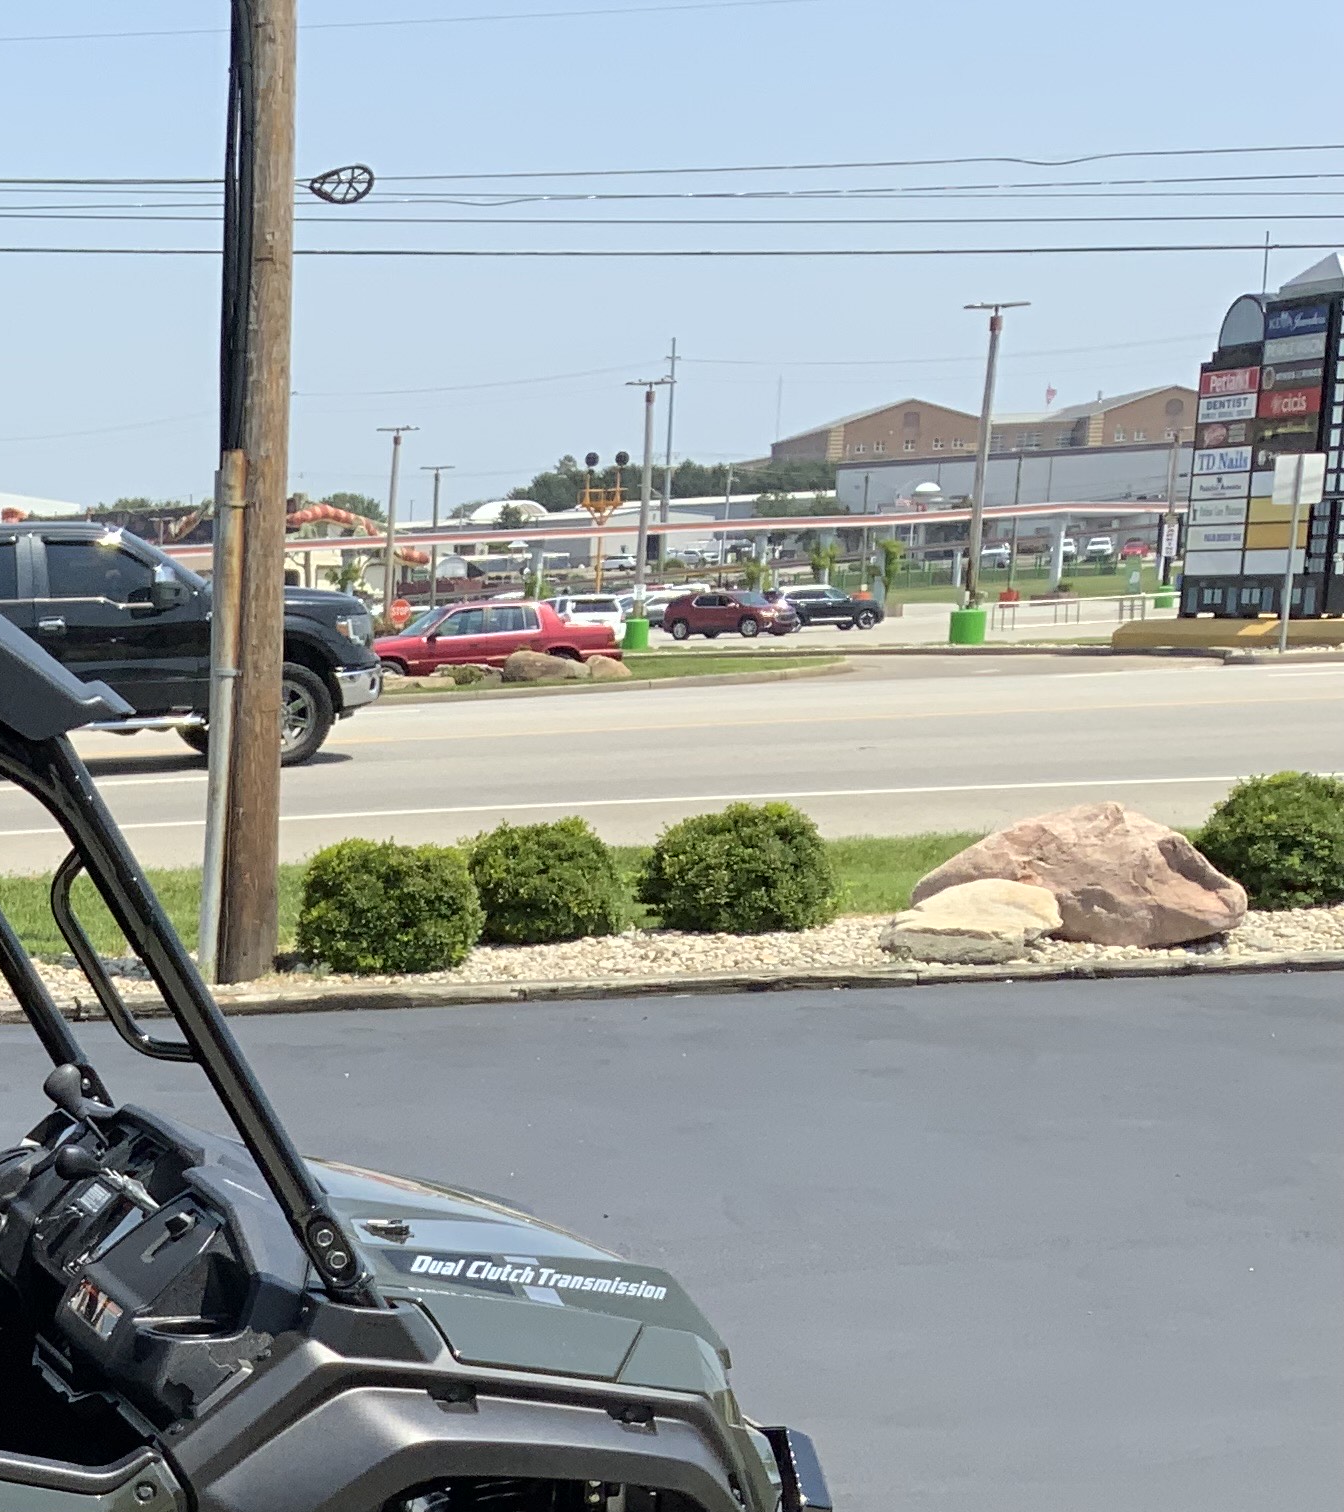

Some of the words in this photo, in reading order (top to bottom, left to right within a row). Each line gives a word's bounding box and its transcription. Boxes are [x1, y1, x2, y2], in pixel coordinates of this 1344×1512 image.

[1206, 397, 1249, 411] DENTIST
[1198, 453, 1216, 471] TD
[1219, 450, 1248, 470] Nails
[392, 606, 410, 616] STOP
[411, 1255, 465, 1277] Dual
[465, 1260, 535, 1286] Clutch
[536, 1268, 667, 1300] Transmission
